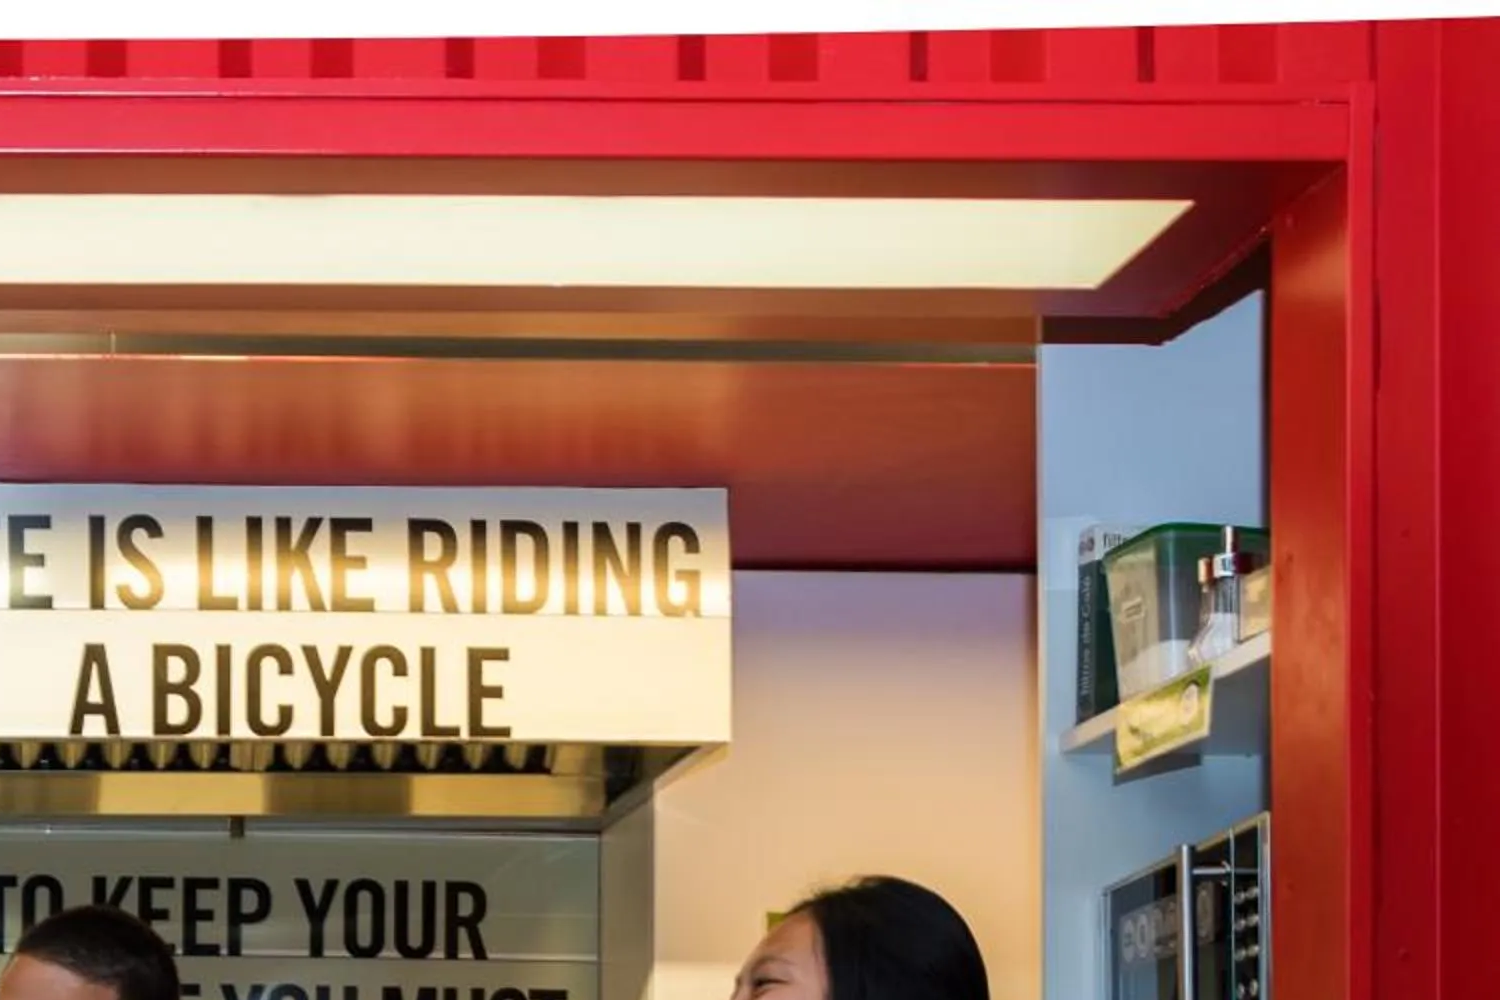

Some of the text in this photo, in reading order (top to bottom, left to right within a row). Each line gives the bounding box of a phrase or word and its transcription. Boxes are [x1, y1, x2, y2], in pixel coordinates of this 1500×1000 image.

[88, 513, 165, 611] IS
[196, 515, 375, 613] LIKE
[407, 517, 702, 618] RIDING
[68, 642, 512, 739] A BICYCLE
[294, 877, 489, 960] YOUR
